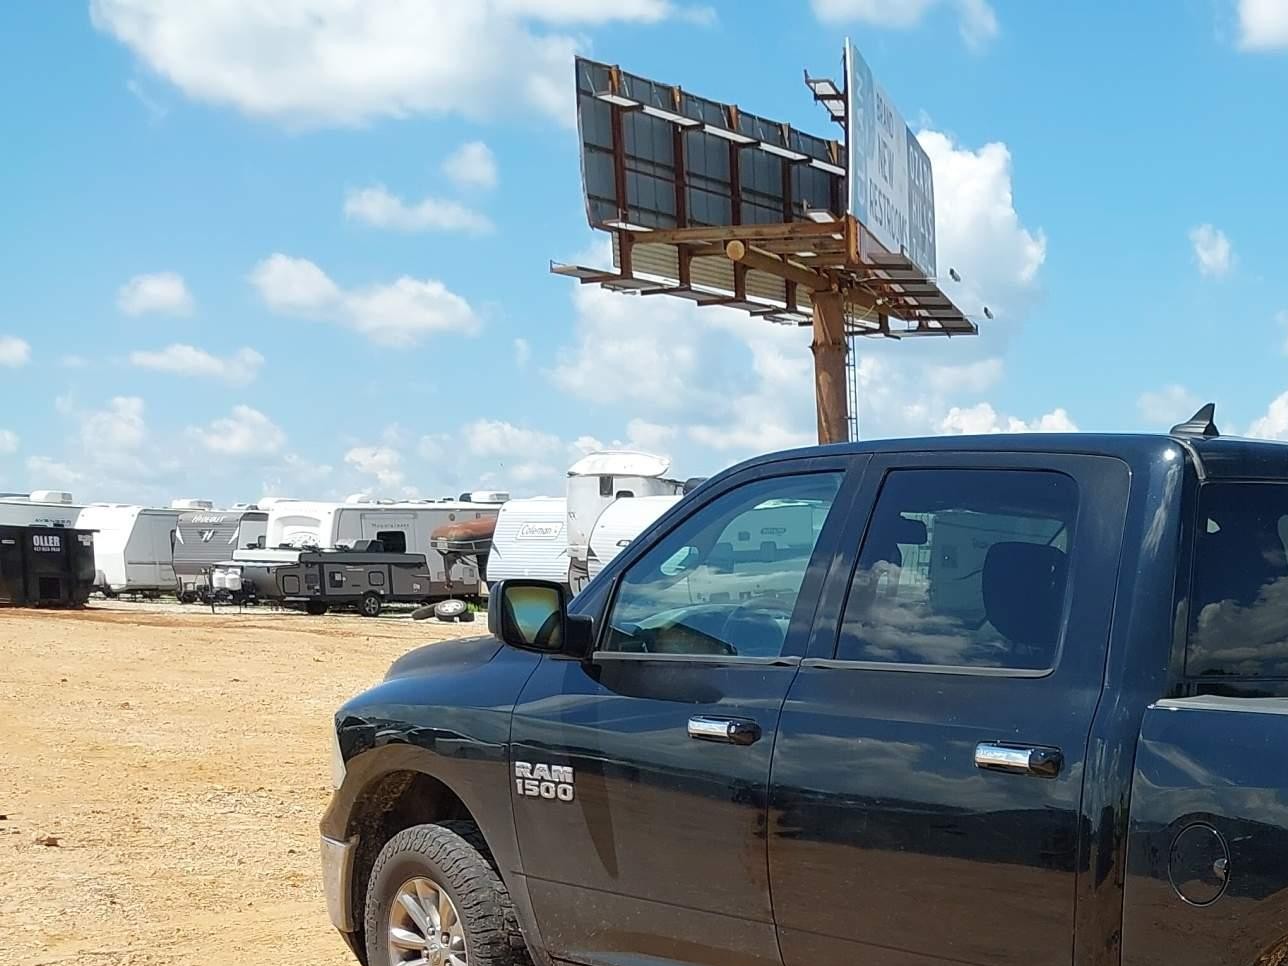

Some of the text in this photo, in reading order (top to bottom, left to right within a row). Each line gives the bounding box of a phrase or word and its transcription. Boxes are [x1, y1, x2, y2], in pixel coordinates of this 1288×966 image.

[878, 130, 894, 190] NEW
[33, 535, 61, 547] OLLER
[515, 761, 574, 784] RAM
[516, 779, 574, 801] 1500
